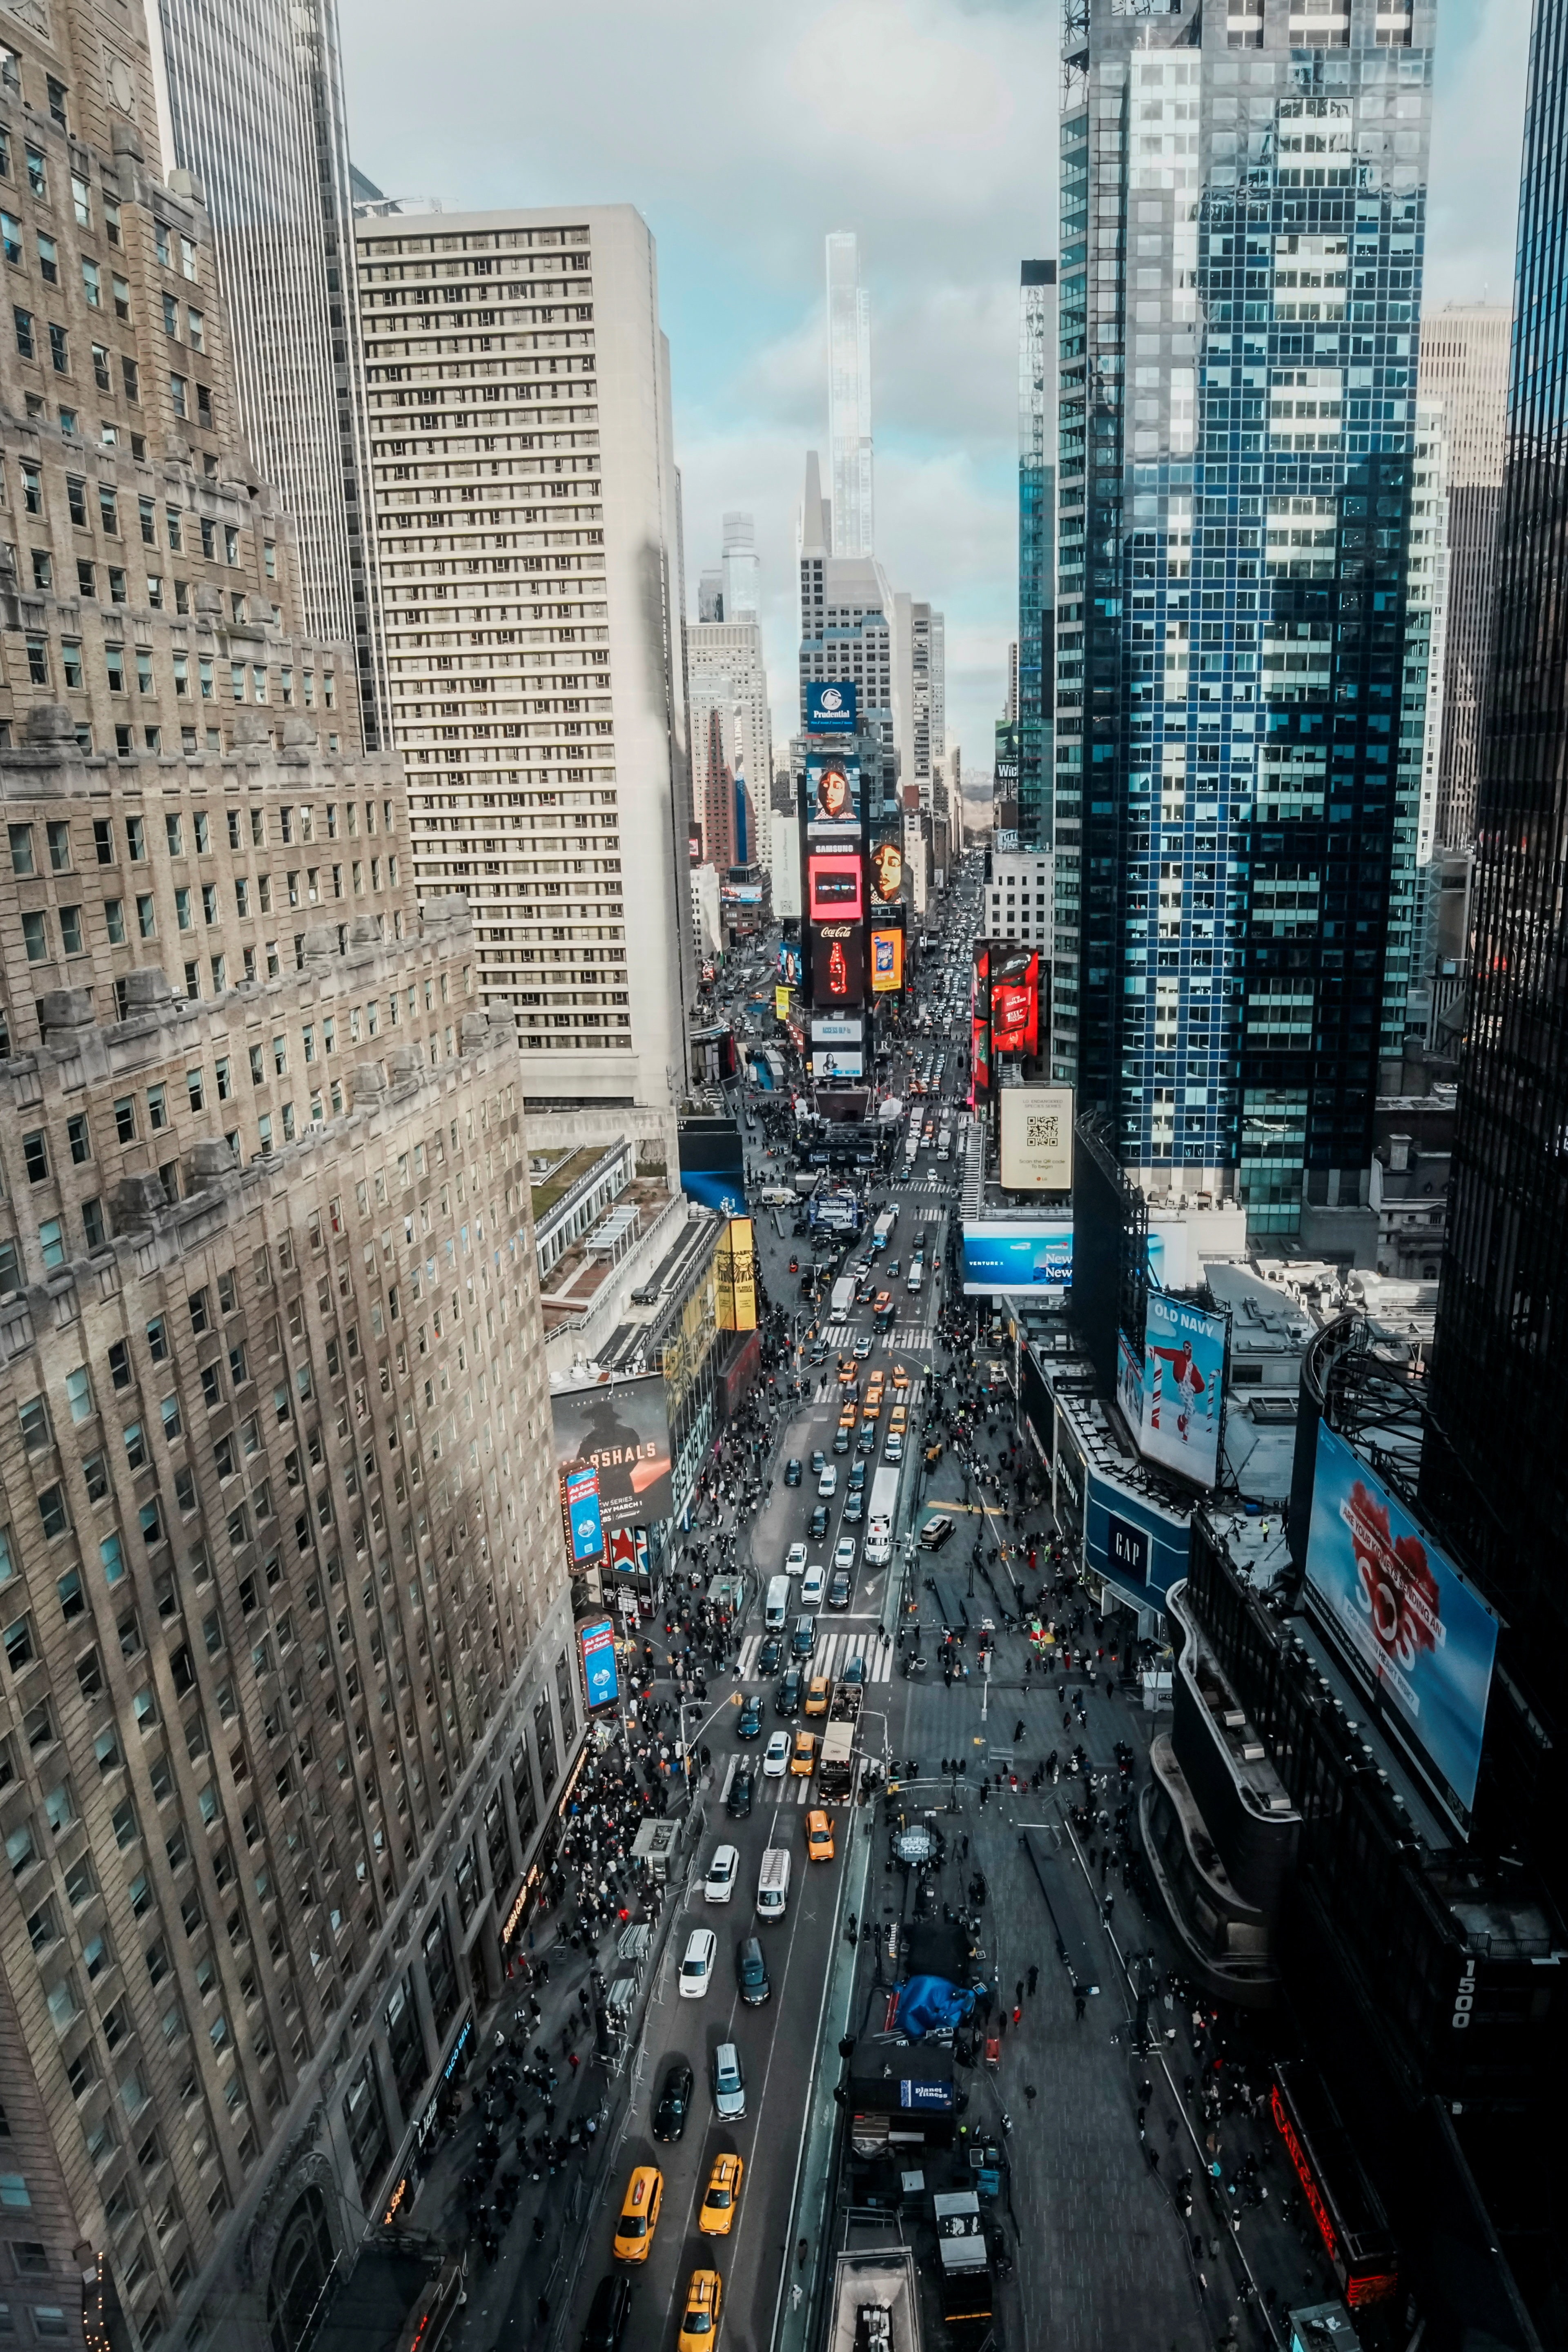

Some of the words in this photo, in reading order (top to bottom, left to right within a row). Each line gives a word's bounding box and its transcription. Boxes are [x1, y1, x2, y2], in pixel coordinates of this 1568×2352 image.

[1046, 1254, 1073, 1264] New
[1046, 1267, 1073, 1277] New
[1155, 1304, 1178, 1323] OLD
[1181, 1313, 1214, 1337] NAVY
[610, 1496, 633, 1506] SERIES
[613, 1501, 638, 1512] MARCH
[1116, 1532, 1139, 1566] GAP
[1343, 1506, 1354, 1524] ARE
[1355, 1517, 1371, 1547] YOUR
[1372, 1544, 1399, 1582] KIDNEYS
[1399, 1577, 1430, 1623] SENDING
[1430, 1616, 1443, 1638] AN
[1355, 1556, 1418, 1671] SOS
[1378, 1649, 1396, 1679] HEART
[1397, 1676, 1414, 1704] RISK?
[1452, 1960, 1475, 2028] 1500
[445, 2048, 459, 2080] TACO
[458, 2022, 470, 2049] BELL
